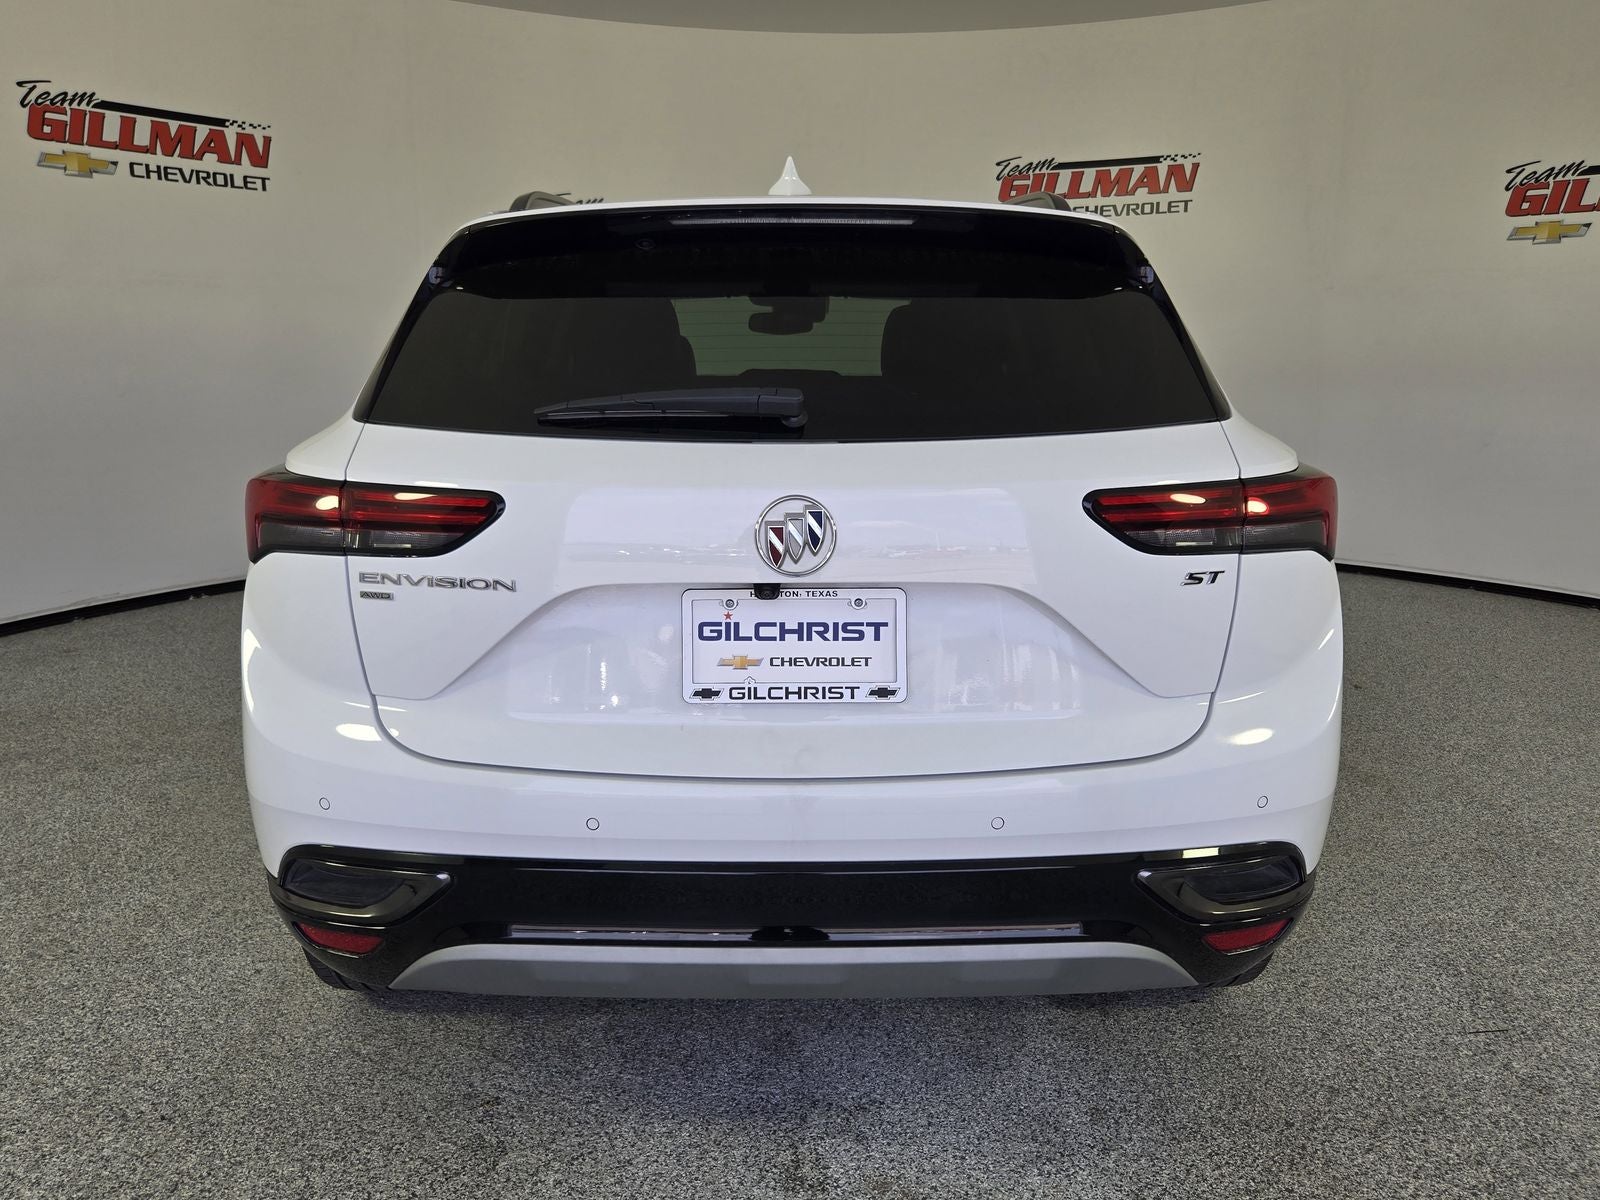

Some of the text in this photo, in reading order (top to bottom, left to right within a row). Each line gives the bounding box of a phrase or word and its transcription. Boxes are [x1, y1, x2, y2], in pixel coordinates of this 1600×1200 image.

[16, 80, 99, 108] Team
[27, 103, 272, 168] GILLMAN
[129, 162, 271, 191] CHEVROLET
[995, 156, 1058, 181] Team
[1504, 160, 1586, 192] Team
[998, 162, 1200, 202] GILLMAN
[1505, 178, 1600, 217] GIL
[358, 571, 517, 592] ENVISION
[1180, 570, 1225, 586] ST
[360, 591, 394, 600] AWD
[750, 590, 838, 598] HTON, TEXAS
[697, 620, 889, 642] GILCHRIST
[769, 656, 872, 667] CHEVROLET
[728, 686, 860, 700] GILCHRIST
